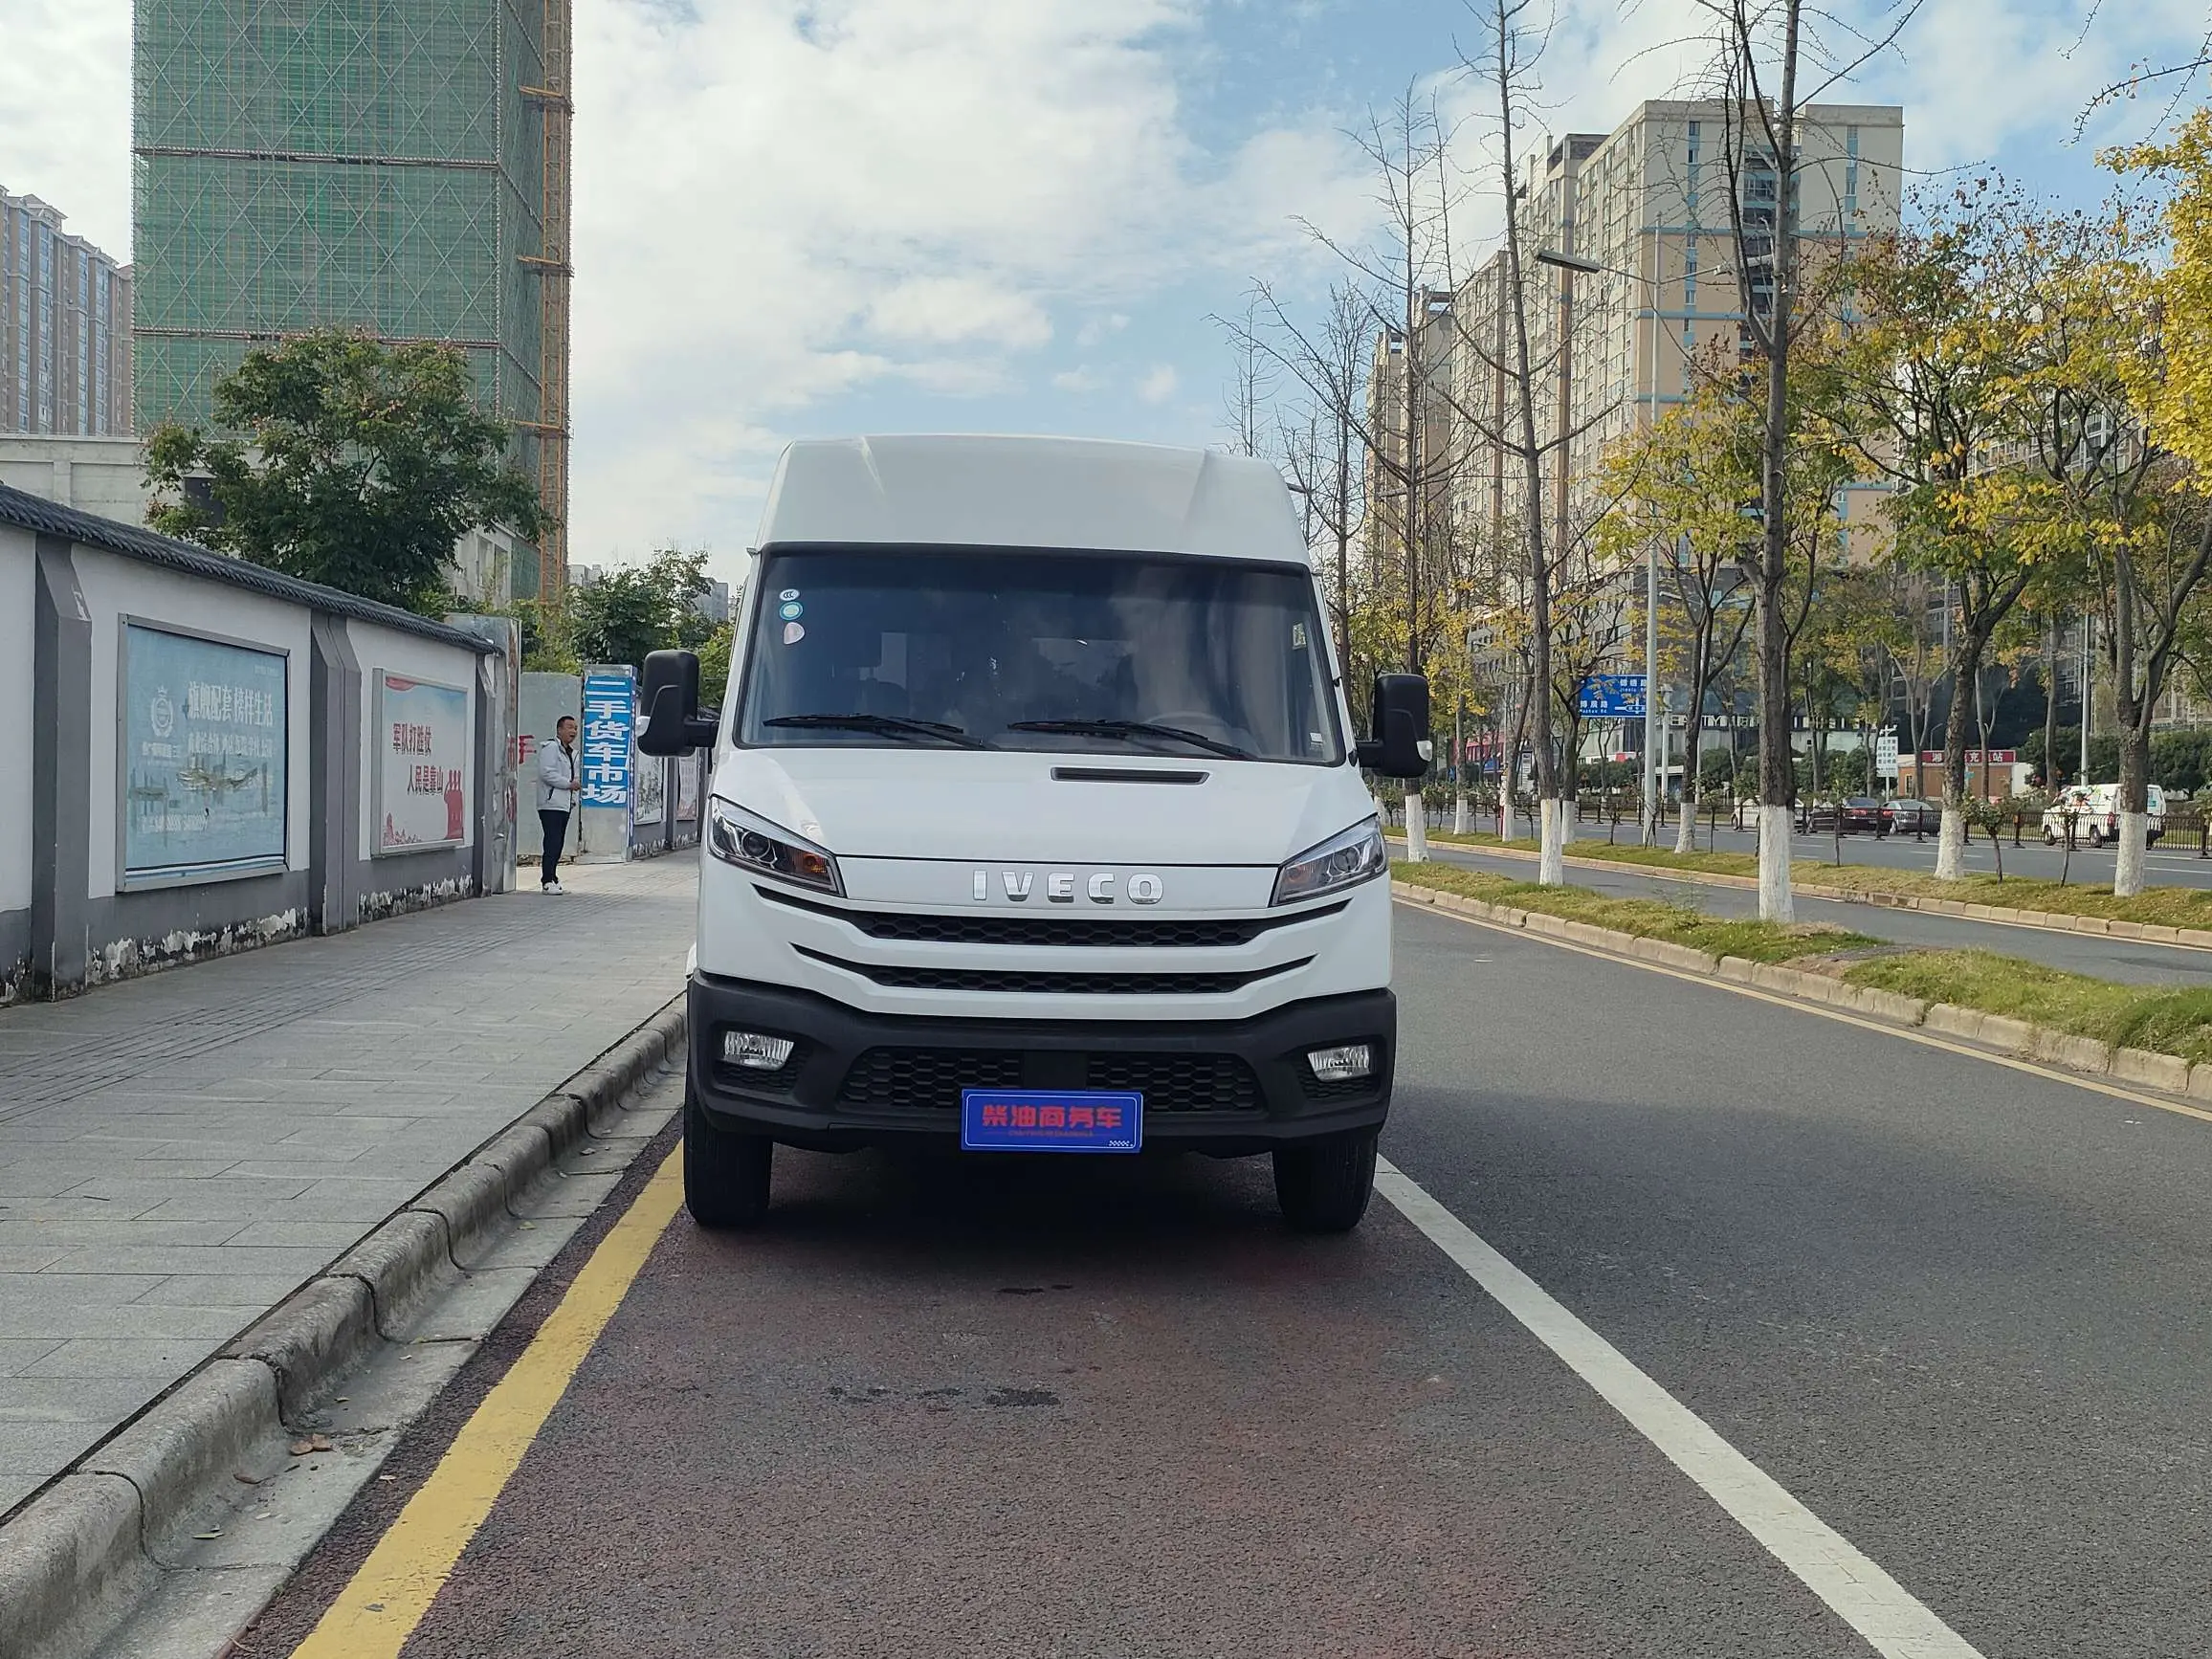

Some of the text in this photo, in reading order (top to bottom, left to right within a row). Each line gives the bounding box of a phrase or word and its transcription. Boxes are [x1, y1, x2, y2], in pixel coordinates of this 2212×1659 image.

[392, 722, 431, 754] 军队打胜仗
[582, 680, 630, 804] 二手货车市场
[407, 764, 444, 795] 人民是靠山
[972, 869, 1164, 905] IVECO
[982, 1104, 1123, 1129] 柴油商务车
